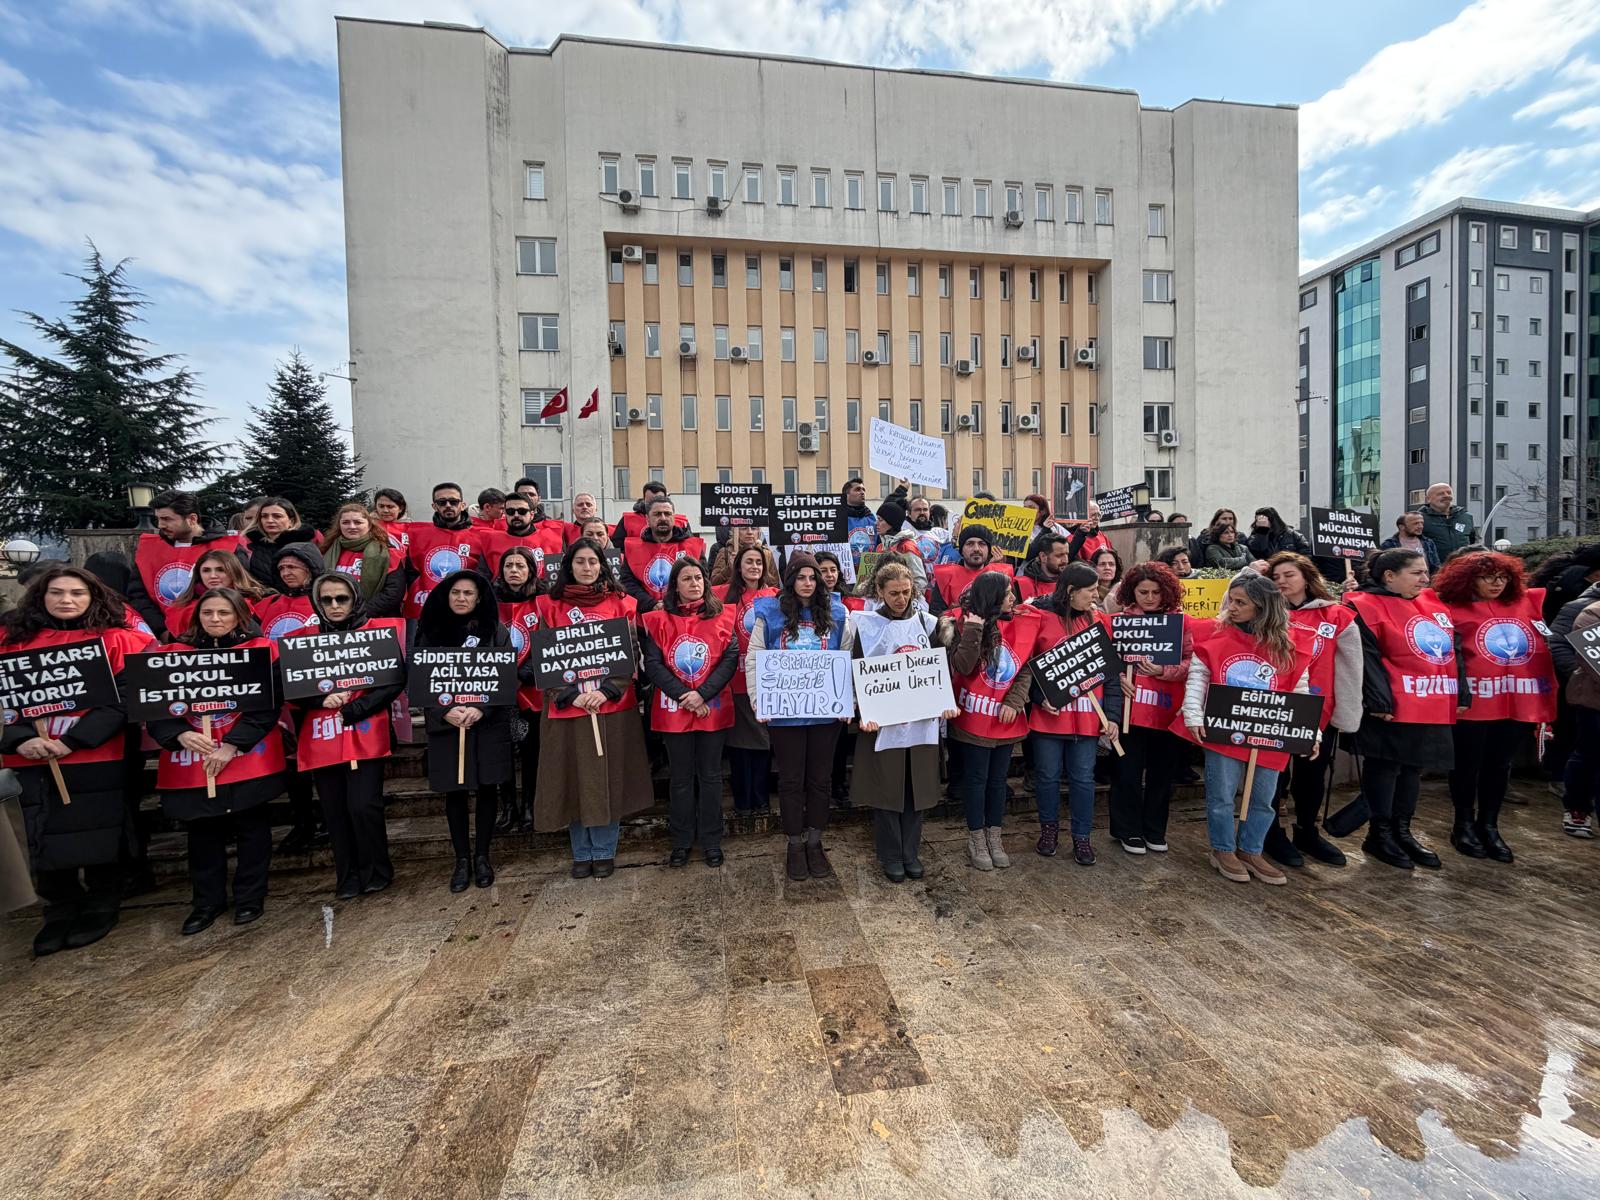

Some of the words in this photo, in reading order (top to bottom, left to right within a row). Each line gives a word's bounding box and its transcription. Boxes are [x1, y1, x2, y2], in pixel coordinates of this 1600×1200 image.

[714, 484, 758, 494] ŞİDDETE
[720, 497, 752, 509] KARŞI
[774, 496, 842, 507] EĞİTİMDE
[704, 506, 769, 516] BİRLİKTEYİZ
[777, 508, 837, 520] ŞİDDETE
[1328, 511, 1362, 524] BİRLİK
[783, 521, 813, 532] DUR
[816, 521, 835, 531] DE
[1319, 522, 1373, 537] MÜCADELE
[1317, 535, 1377, 549] DAYANIŞMA
[283, 634, 341, 651] YETER
[343, 628, 393, 644] ARTIK
[555, 624, 605, 641] BİRLİK
[1112, 629, 1153, 639] OKUL
[312, 646, 372, 663] ÖLMEK
[542, 635, 622, 658] MÜCADELE
[1036, 626, 1101, 670] EĞİTİMDE
[39, 645, 102, 667] KARŞI
[147, 649, 250, 669] GÜVENLİ
[413, 649, 472, 665] ŞİDDETE
[476, 652, 516, 664] KARŞI
[540, 650, 628, 673] DAYANIŞMA
[1044, 642, 1103, 681] ŞİDDETE
[24, 666, 82, 686] YASA
[169, 669, 233, 684] OKUL
[286, 658, 398, 683] İSTEMİYORUZ
[430, 663, 462, 678] ACİL
[464, 666, 499, 677] YASA
[859, 661, 902, 676] RAHMET
[1056, 669, 1087, 691] DUR
[1087, 657, 1107, 675] DE
[139, 683, 262, 704] İSTİYORUZ
[430, 678, 499, 693] İSTİYORUZ
[761, 691, 829, 717] HAYIR
[1241, 691, 1286, 705] EĞİTİM
[1231, 704, 1293, 722] EMEKCİSİ
[1206, 716, 1251, 731] YALNIZ
[1253, 721, 1314, 740] DEĞİLDİR
